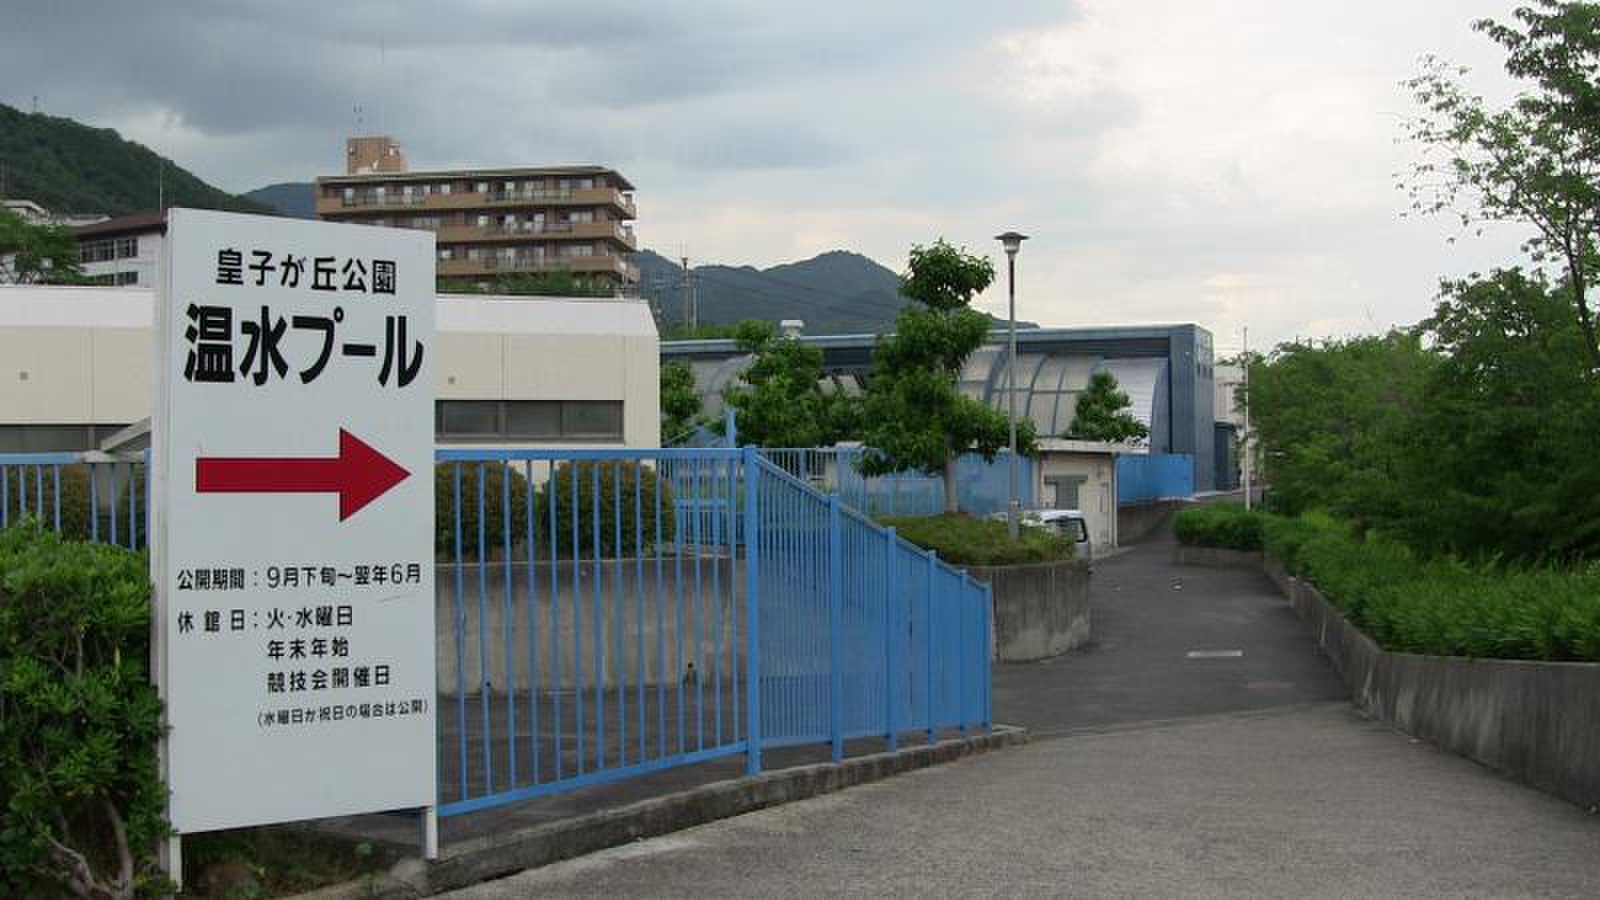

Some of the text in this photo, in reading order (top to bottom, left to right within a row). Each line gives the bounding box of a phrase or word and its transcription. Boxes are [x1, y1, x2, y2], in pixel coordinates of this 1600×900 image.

[215, 248, 396, 295] 皇子が丘公園
[183, 303, 424, 388] 温水プール
[267, 636, 349, 661] 年末年始
[267, 665, 390, 693] 競技会開催日
